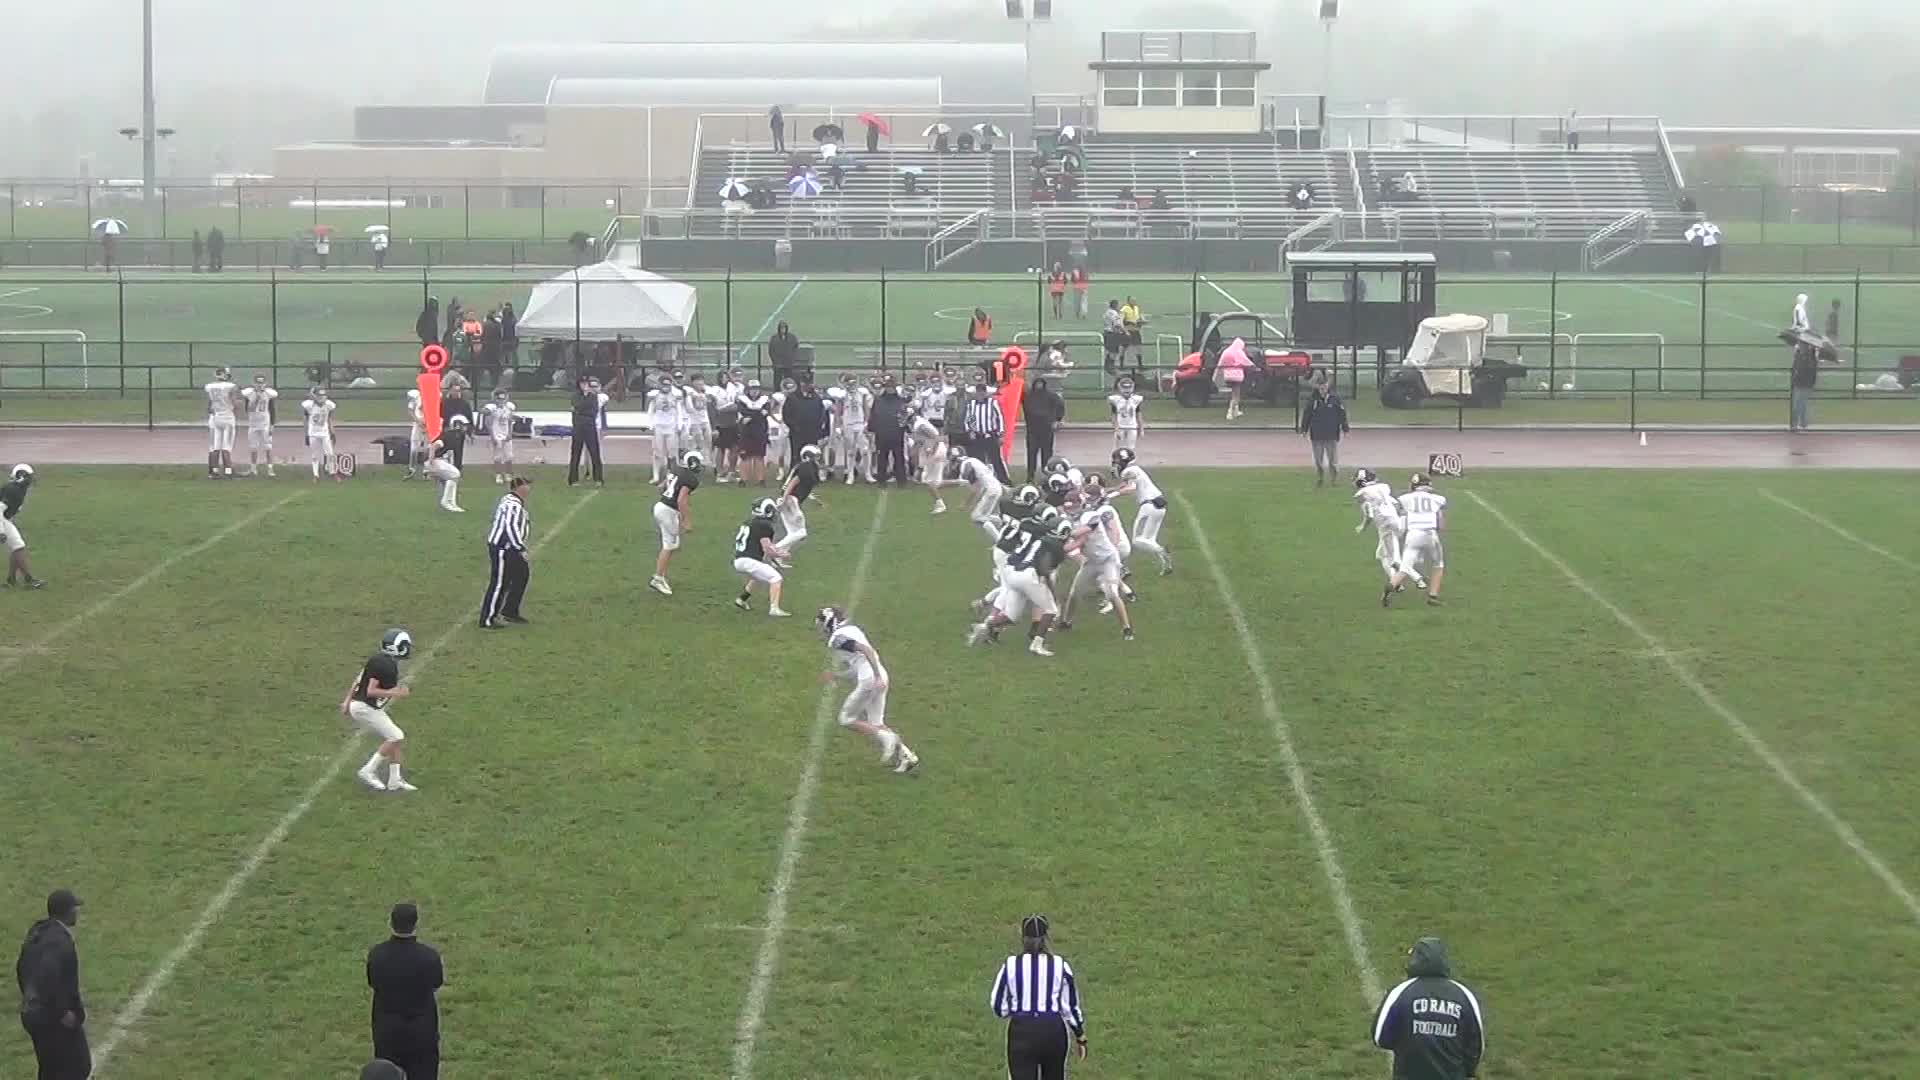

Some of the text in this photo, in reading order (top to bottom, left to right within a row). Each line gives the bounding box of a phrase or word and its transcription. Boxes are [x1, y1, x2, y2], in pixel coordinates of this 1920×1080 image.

[1431, 454, 1461, 476] 40
[1413, 495, 1432, 513] 10
[1429, 998, 1462, 1019] RAMS
[1413, 1020, 1458, 1037] FOOTBALL
